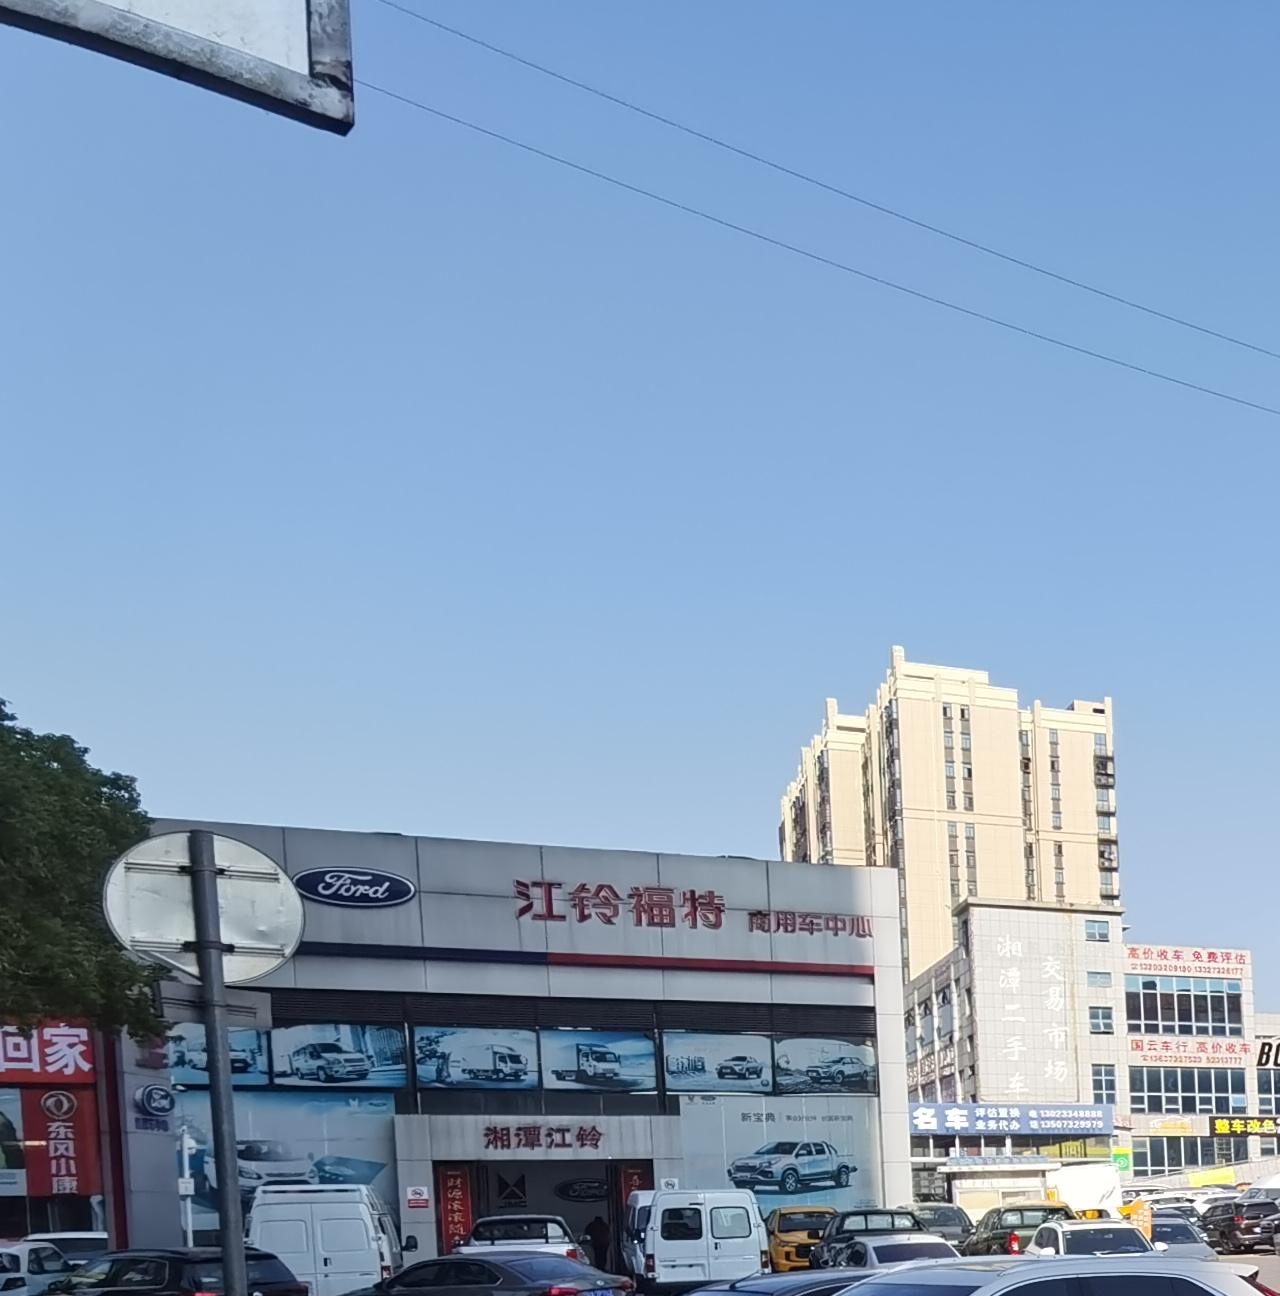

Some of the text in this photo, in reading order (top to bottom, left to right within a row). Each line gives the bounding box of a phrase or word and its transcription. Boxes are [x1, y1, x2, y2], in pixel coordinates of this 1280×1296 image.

[317, 866, 391, 900] Ford
[513, 878, 873, 938] 江铃福特 商用车中心
[1127, 947, 1246, 965] 高价收车 免费评估
[997, 934, 1029, 1100] 湘潭二手车
[1041, 956, 1069, 1082] 交易市场
[0, 1023, 93, 1076] 回家
[1196, 1041, 1251, 1054] 高价收车
[912, 1107, 970, 1130] 名车
[975, 1107, 1020, 1118] 评估置换
[975, 1119, 1020, 1131] 业务代办
[483, 1125, 603, 1150] 湘潭江铃
[47, 1121, 79, 1194] 东风小康
